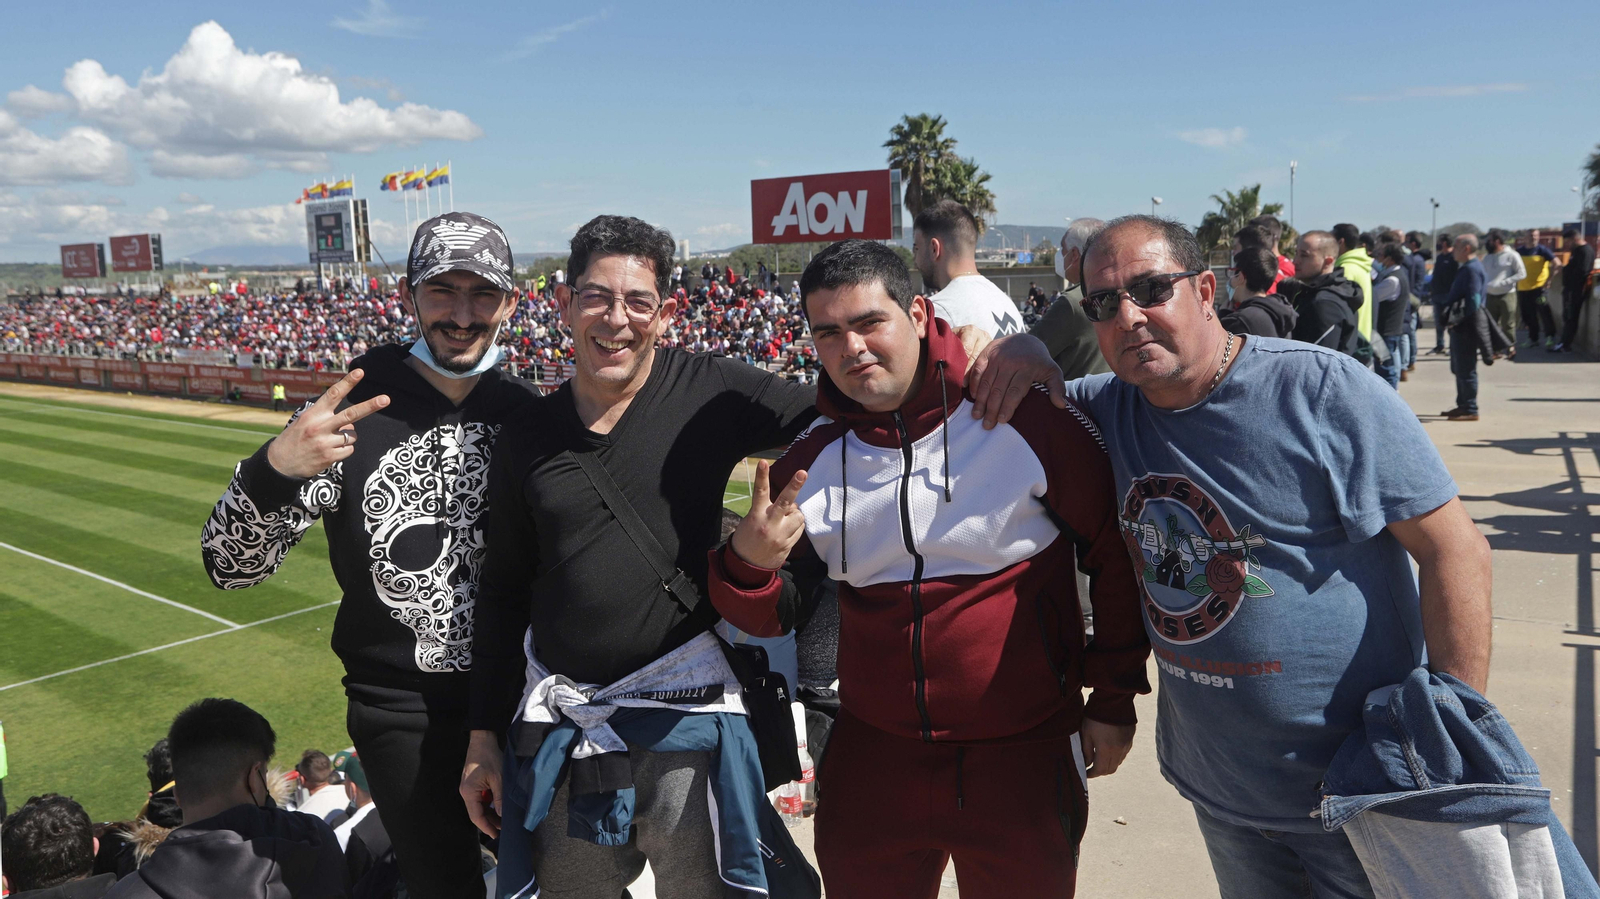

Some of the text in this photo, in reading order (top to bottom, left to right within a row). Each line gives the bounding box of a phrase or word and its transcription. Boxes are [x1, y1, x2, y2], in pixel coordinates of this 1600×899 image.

[770, 182, 868, 236] AON
[1156, 656, 1234, 689] OUR 1991
[1179, 655, 1283, 677] ILLUSION
